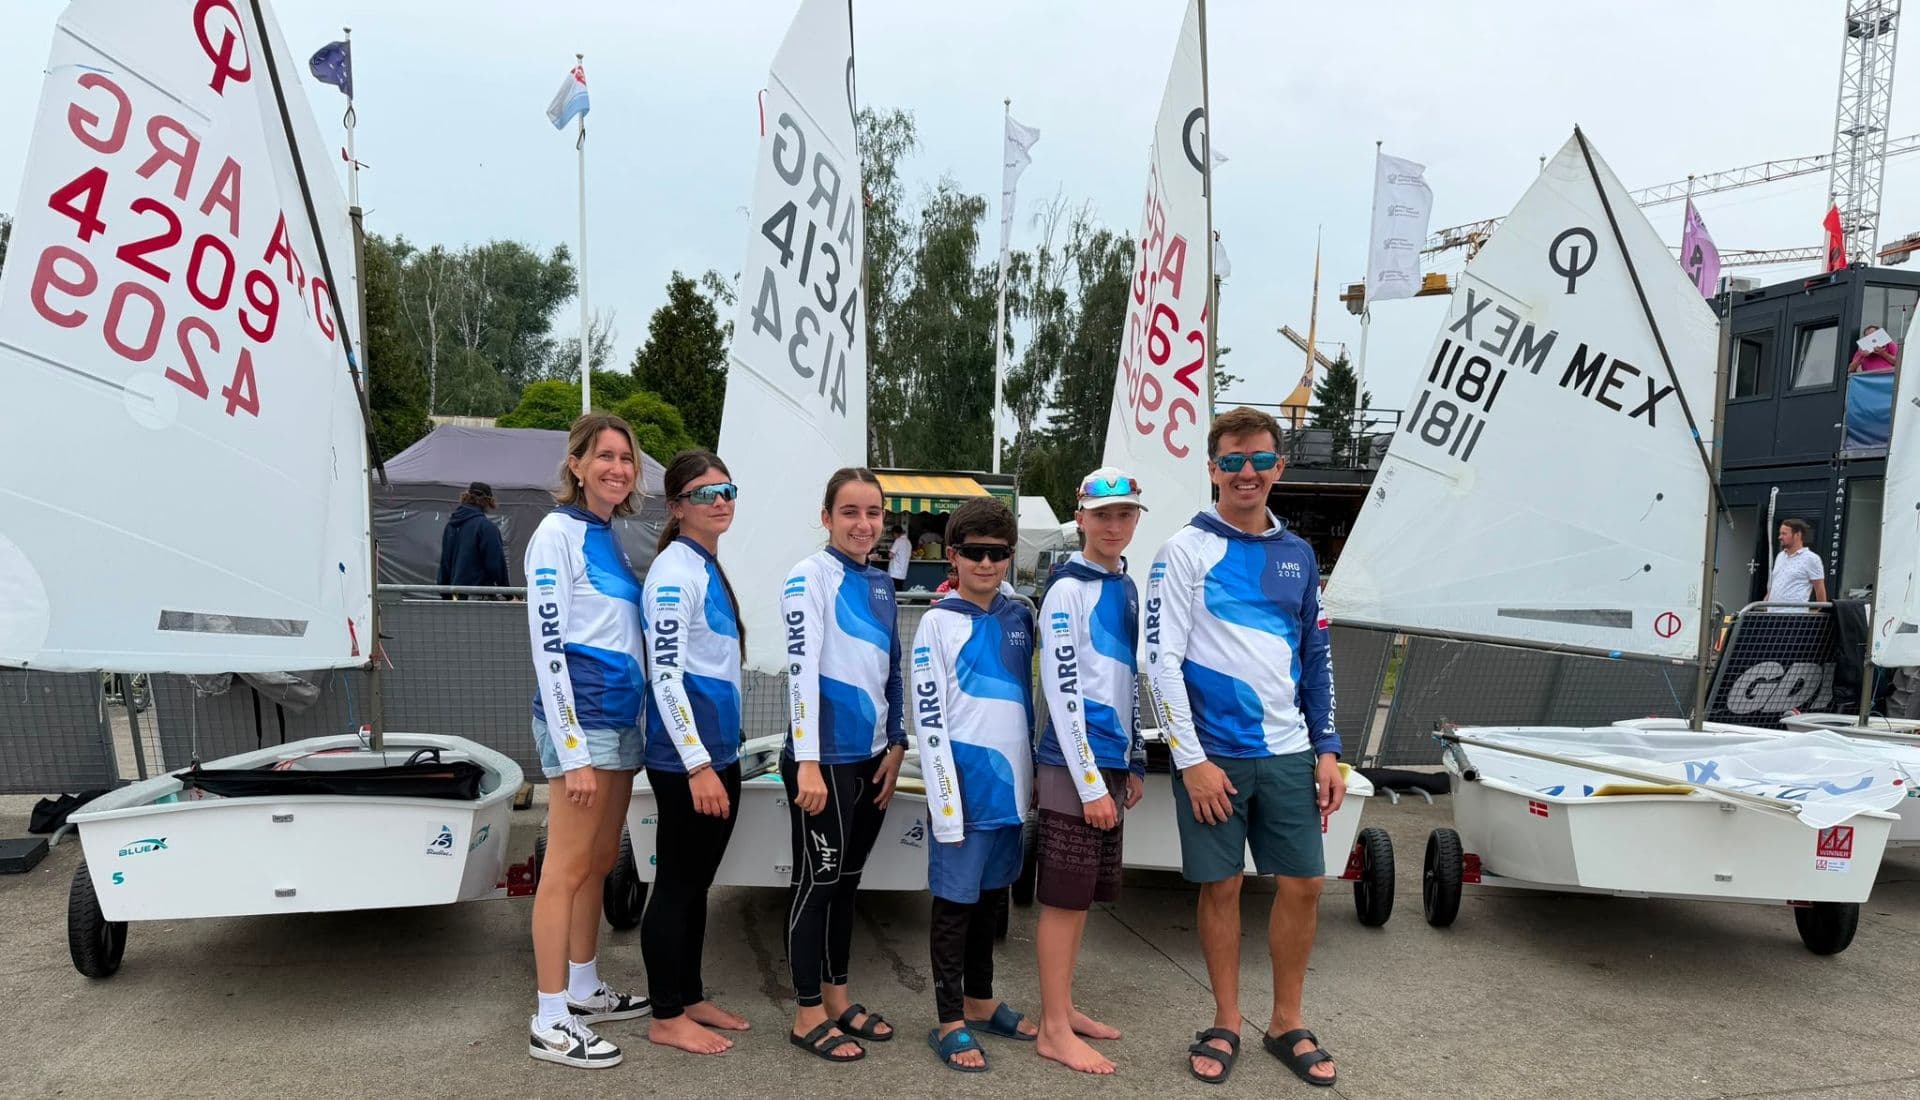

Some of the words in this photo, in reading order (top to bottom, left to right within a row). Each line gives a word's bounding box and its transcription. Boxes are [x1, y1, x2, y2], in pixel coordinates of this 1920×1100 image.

[48, 166, 280, 344] 4209
[761, 200, 858, 350] 4134
[1427, 338, 1508, 414] 1181
[1558, 342, 1677, 428] MEX
[1281, 561, 1300, 571] ARG
[538, 602, 565, 655] ARG
[655, 619, 680, 668] ARG
[786, 610, 806, 657] ARG
[1147, 597, 1162, 645] ARG
[1055, 645, 1079, 696] ARG
[917, 680, 943, 729] ARG
[810, 829, 838, 875] Zhik
[1819, 849, 1851, 858] WINNER
[112, 871, 125, 885] 5
